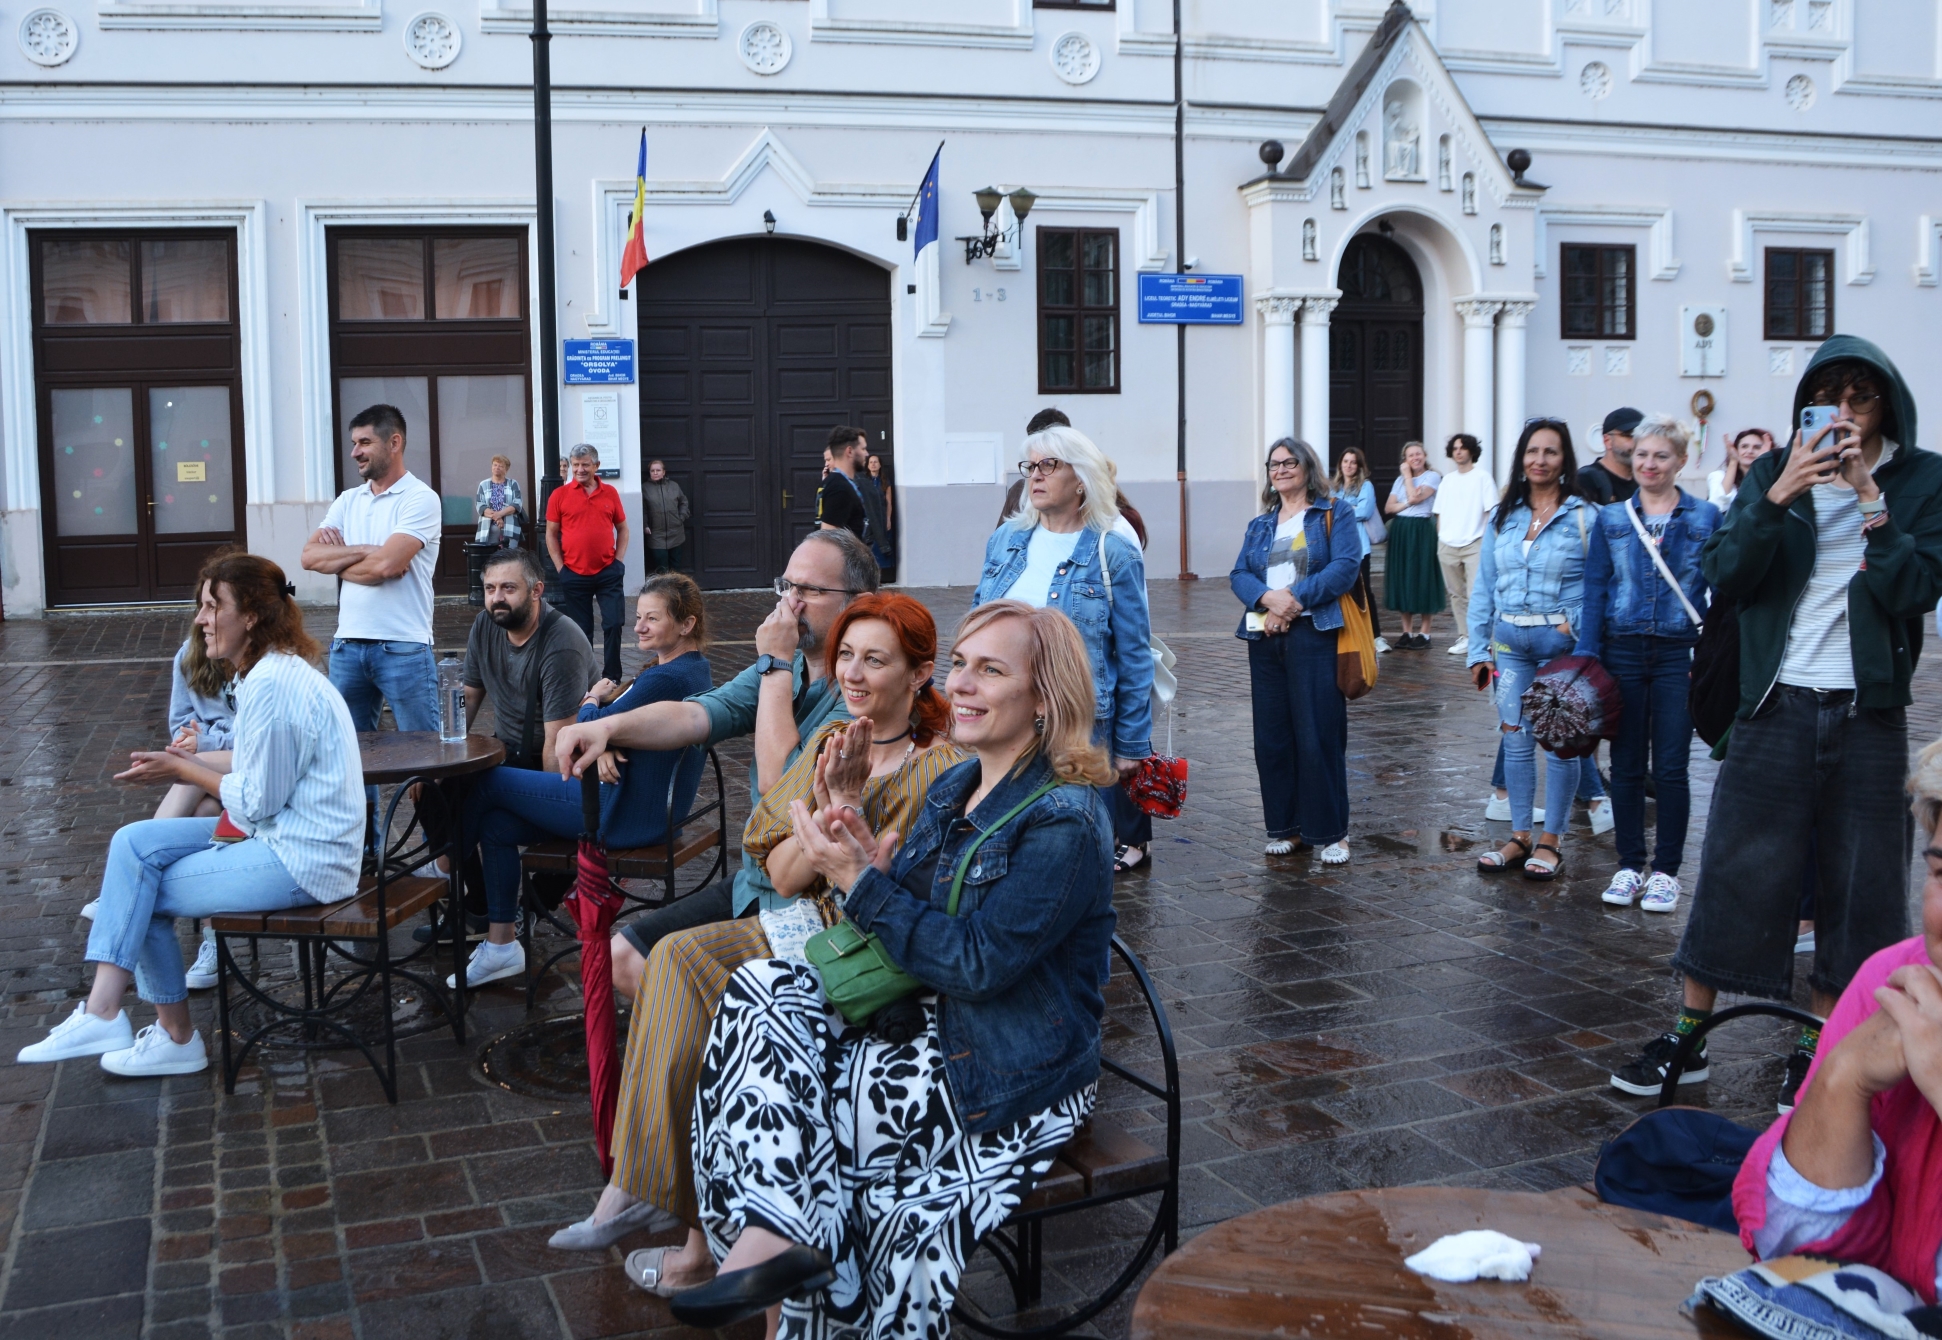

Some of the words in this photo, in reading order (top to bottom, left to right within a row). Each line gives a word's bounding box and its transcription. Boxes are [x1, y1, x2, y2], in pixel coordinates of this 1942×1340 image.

[973, 288, 982, 301] 1
[997, 288, 1006, 301] 3
[1694, 339, 1714, 349] ADY
